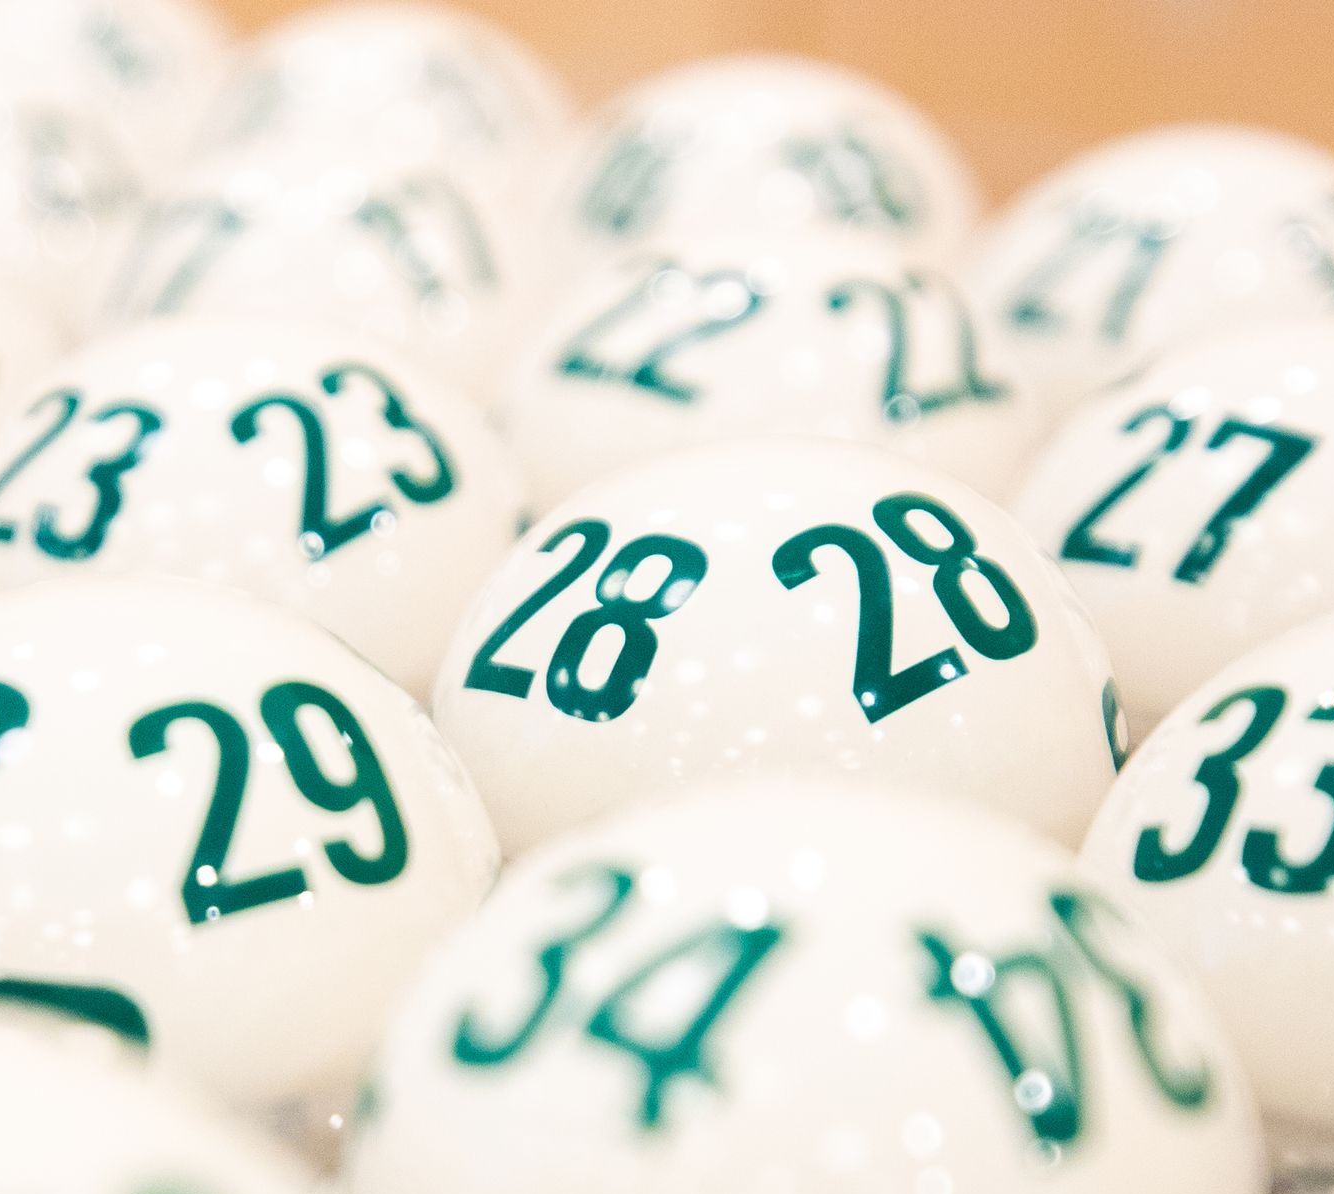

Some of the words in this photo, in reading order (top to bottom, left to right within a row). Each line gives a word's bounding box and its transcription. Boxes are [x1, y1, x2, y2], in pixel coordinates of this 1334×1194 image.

[230, 362, 457, 562] 23
[1060, 402, 1322, 585] 27
[463, 518, 710, 723] 28
[772, 490, 1039, 725] 28
[126, 681, 410, 926] 29
[451, 864, 789, 1132] 34
[911, 888, 1214, 1145] 34
